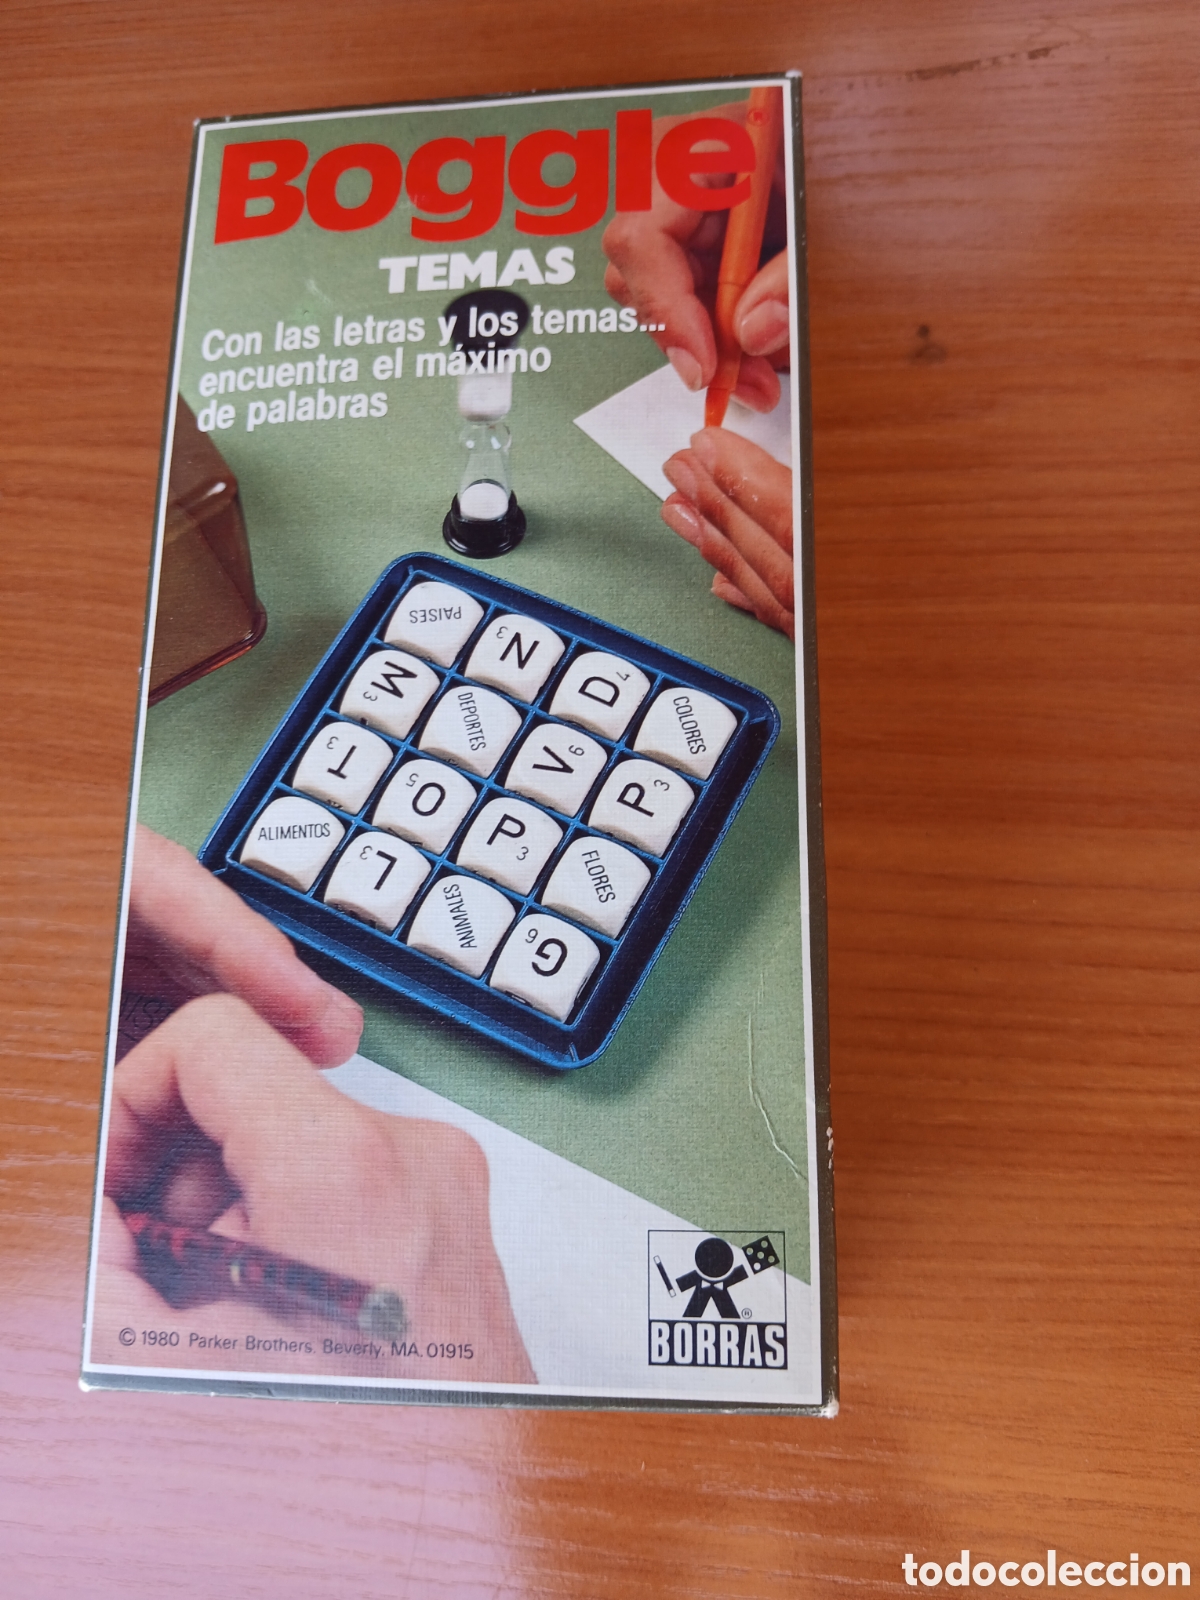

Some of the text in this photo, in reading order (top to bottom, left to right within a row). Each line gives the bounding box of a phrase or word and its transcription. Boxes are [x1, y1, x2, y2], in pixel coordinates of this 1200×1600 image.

[213, 108, 757, 244] Boggle
[378, 246, 576, 294] TEMAS
[202, 304, 666, 361] Con las letras y los temas...
[199, 342, 552, 397] encuentra el máximo
[197, 388, 389, 432] de palabras
[409, 606, 462, 624] PAISES
[496, 626, 541, 671] N 3
[370, 660, 419, 700] M
[578, 676, 620, 708] D
[457, 691, 488, 752] DEPORTES
[673, 696, 707, 755] COLORES
[326, 744, 358, 780] T
[532, 745, 574, 774] V
[411, 781, 447, 818] O
[616, 779, 671, 817] P 3
[257, 822, 332, 842] ALIMENTOS
[485, 812, 530, 862] P 3
[373, 849, 399, 892] L
[581, 849, 616, 904] FLORES
[443, 883, 478, 949] ANIMALES
[530, 937, 569, 978] G
[141, 1329, 181, 1347] 1980
[188, 1332, 239, 1350] Parker
[426, 1341, 475, 1360] 01915
[650, 1321, 785, 1367] BORRAS
